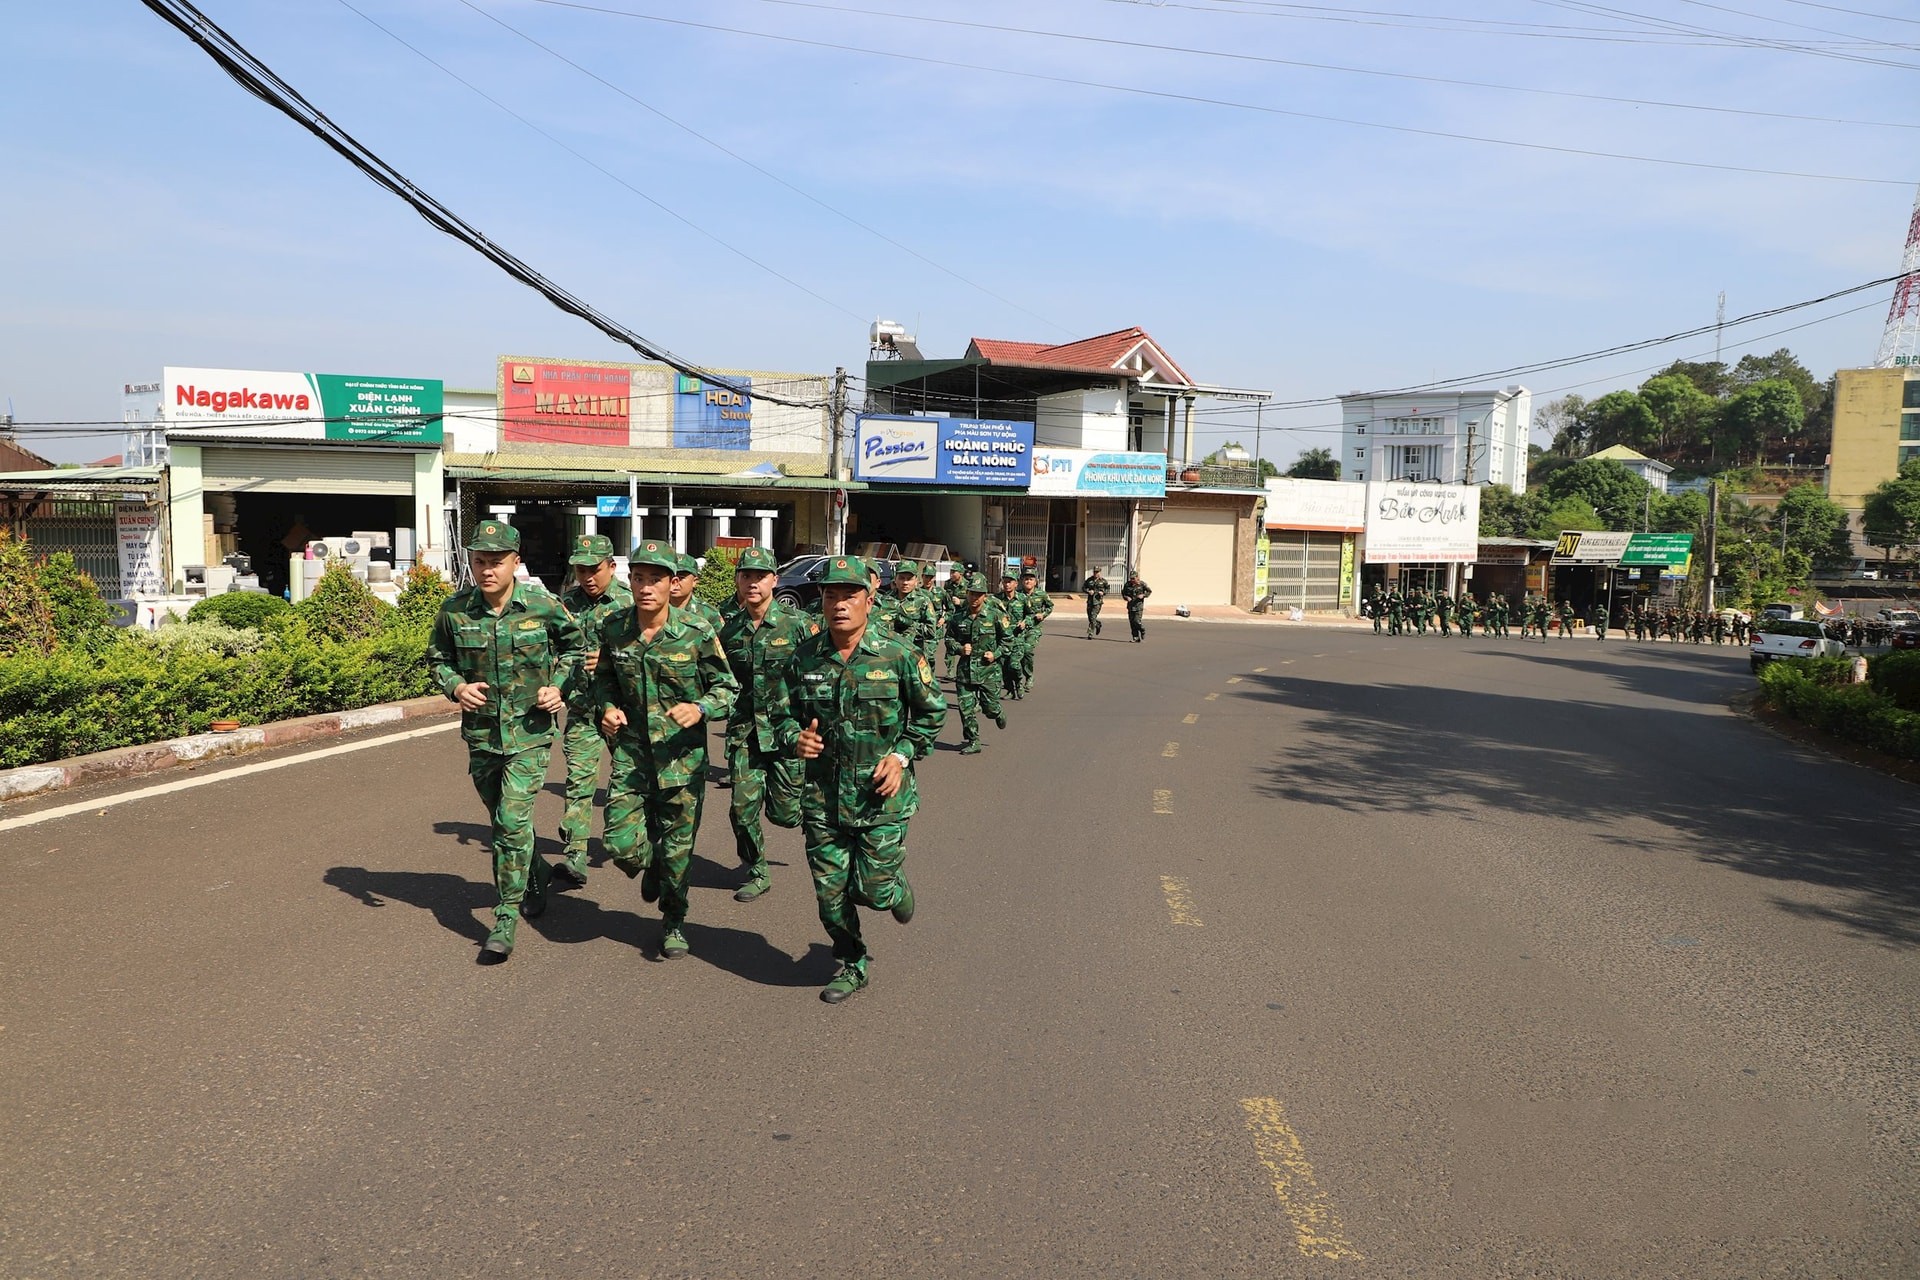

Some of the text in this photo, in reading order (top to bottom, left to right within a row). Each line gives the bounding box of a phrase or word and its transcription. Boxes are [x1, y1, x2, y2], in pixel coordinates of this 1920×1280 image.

[177, 384, 310, 413] Nagakawa
[358, 391, 413, 404] ĐIỆN LẠNH
[349, 403, 421, 415] XUÂN CHÍNH
[535, 392, 628, 417] MAXIMI
[229, 410, 241, 418] NHÀ
[720, 409, 753, 421] Show
[960, 422, 1012, 431] TRUNG TÂM PHỐI VÀ
[966, 429, 979, 437] MÀU
[1001, 430, 1017, 439] ĐỘNG
[865, 435, 925, 460] Passion
[945, 438, 1026, 454] HOÀNG PHÚC
[952, 451, 1017, 468] ĐẮK NÔNG
[1051, 458, 1073, 472] PTI
[1085, 471, 1107, 483] PHÒNG
[1379, 498, 1416, 520] Bảo
